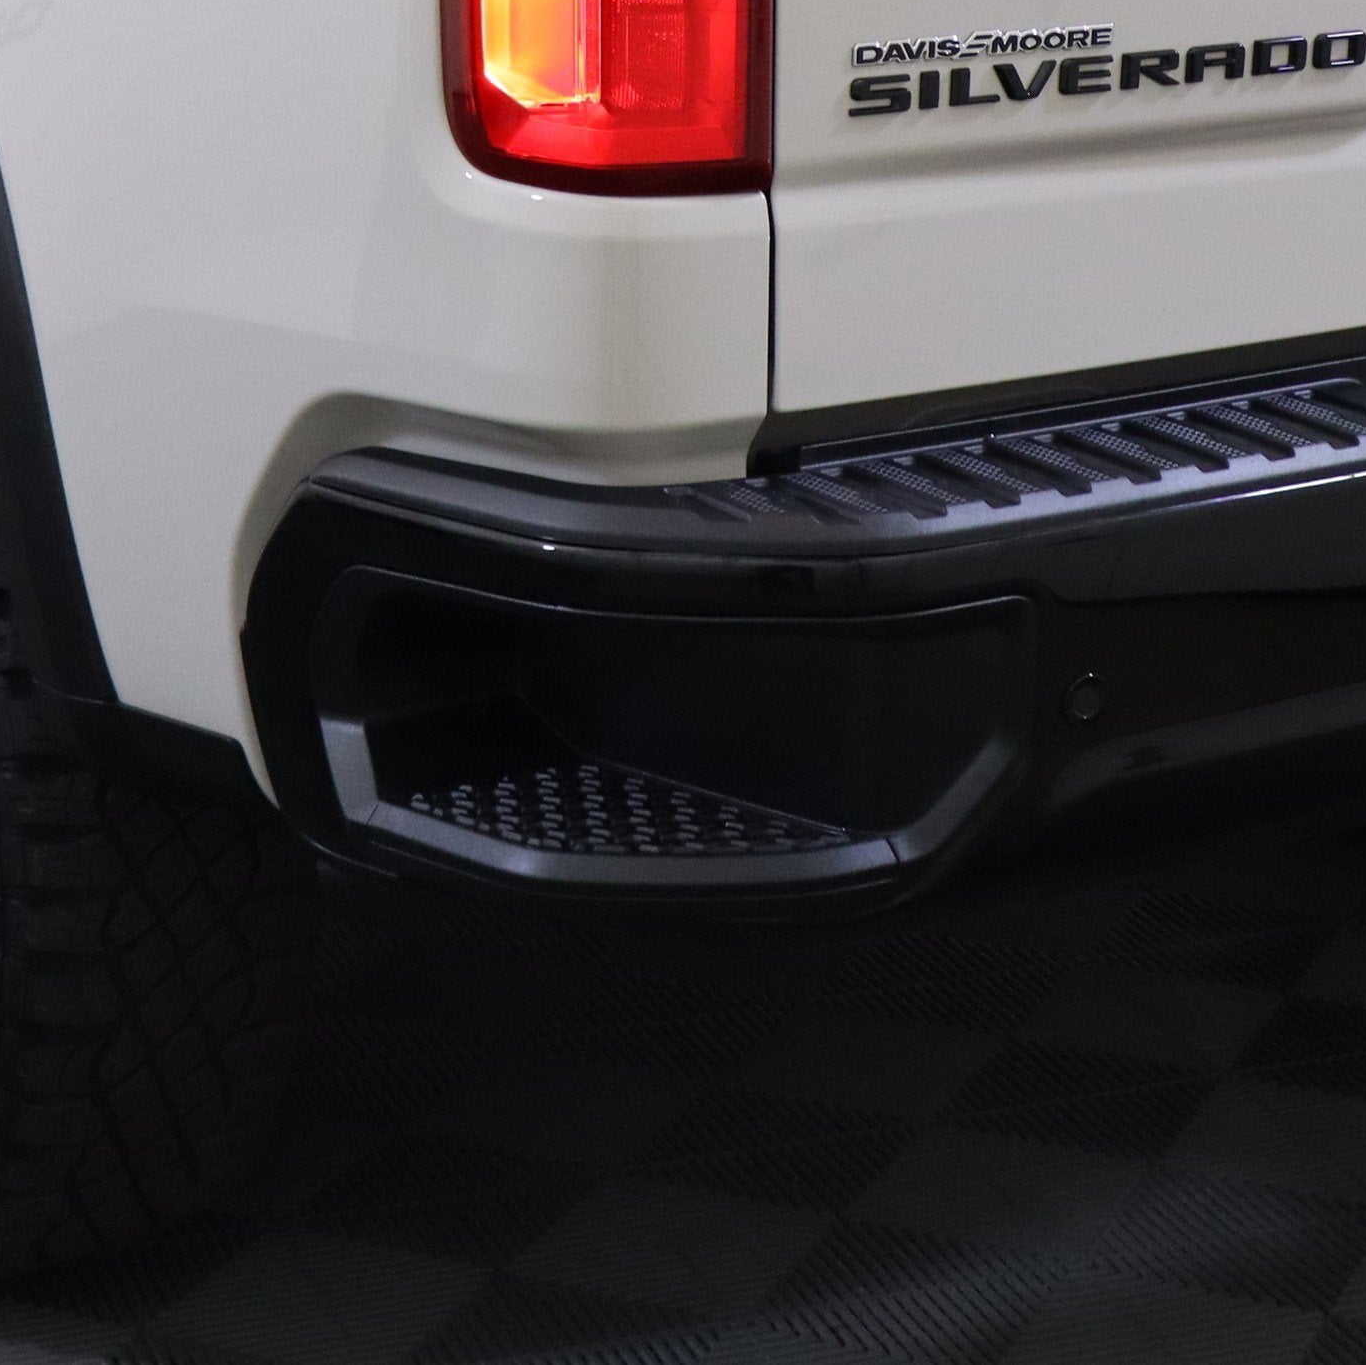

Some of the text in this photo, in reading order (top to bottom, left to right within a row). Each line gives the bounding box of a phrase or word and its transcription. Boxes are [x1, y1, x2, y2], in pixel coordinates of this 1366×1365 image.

[848, 29, 1366, 117] SILVERADO
[854, 26, 1114, 65] DAVIS MOORE
